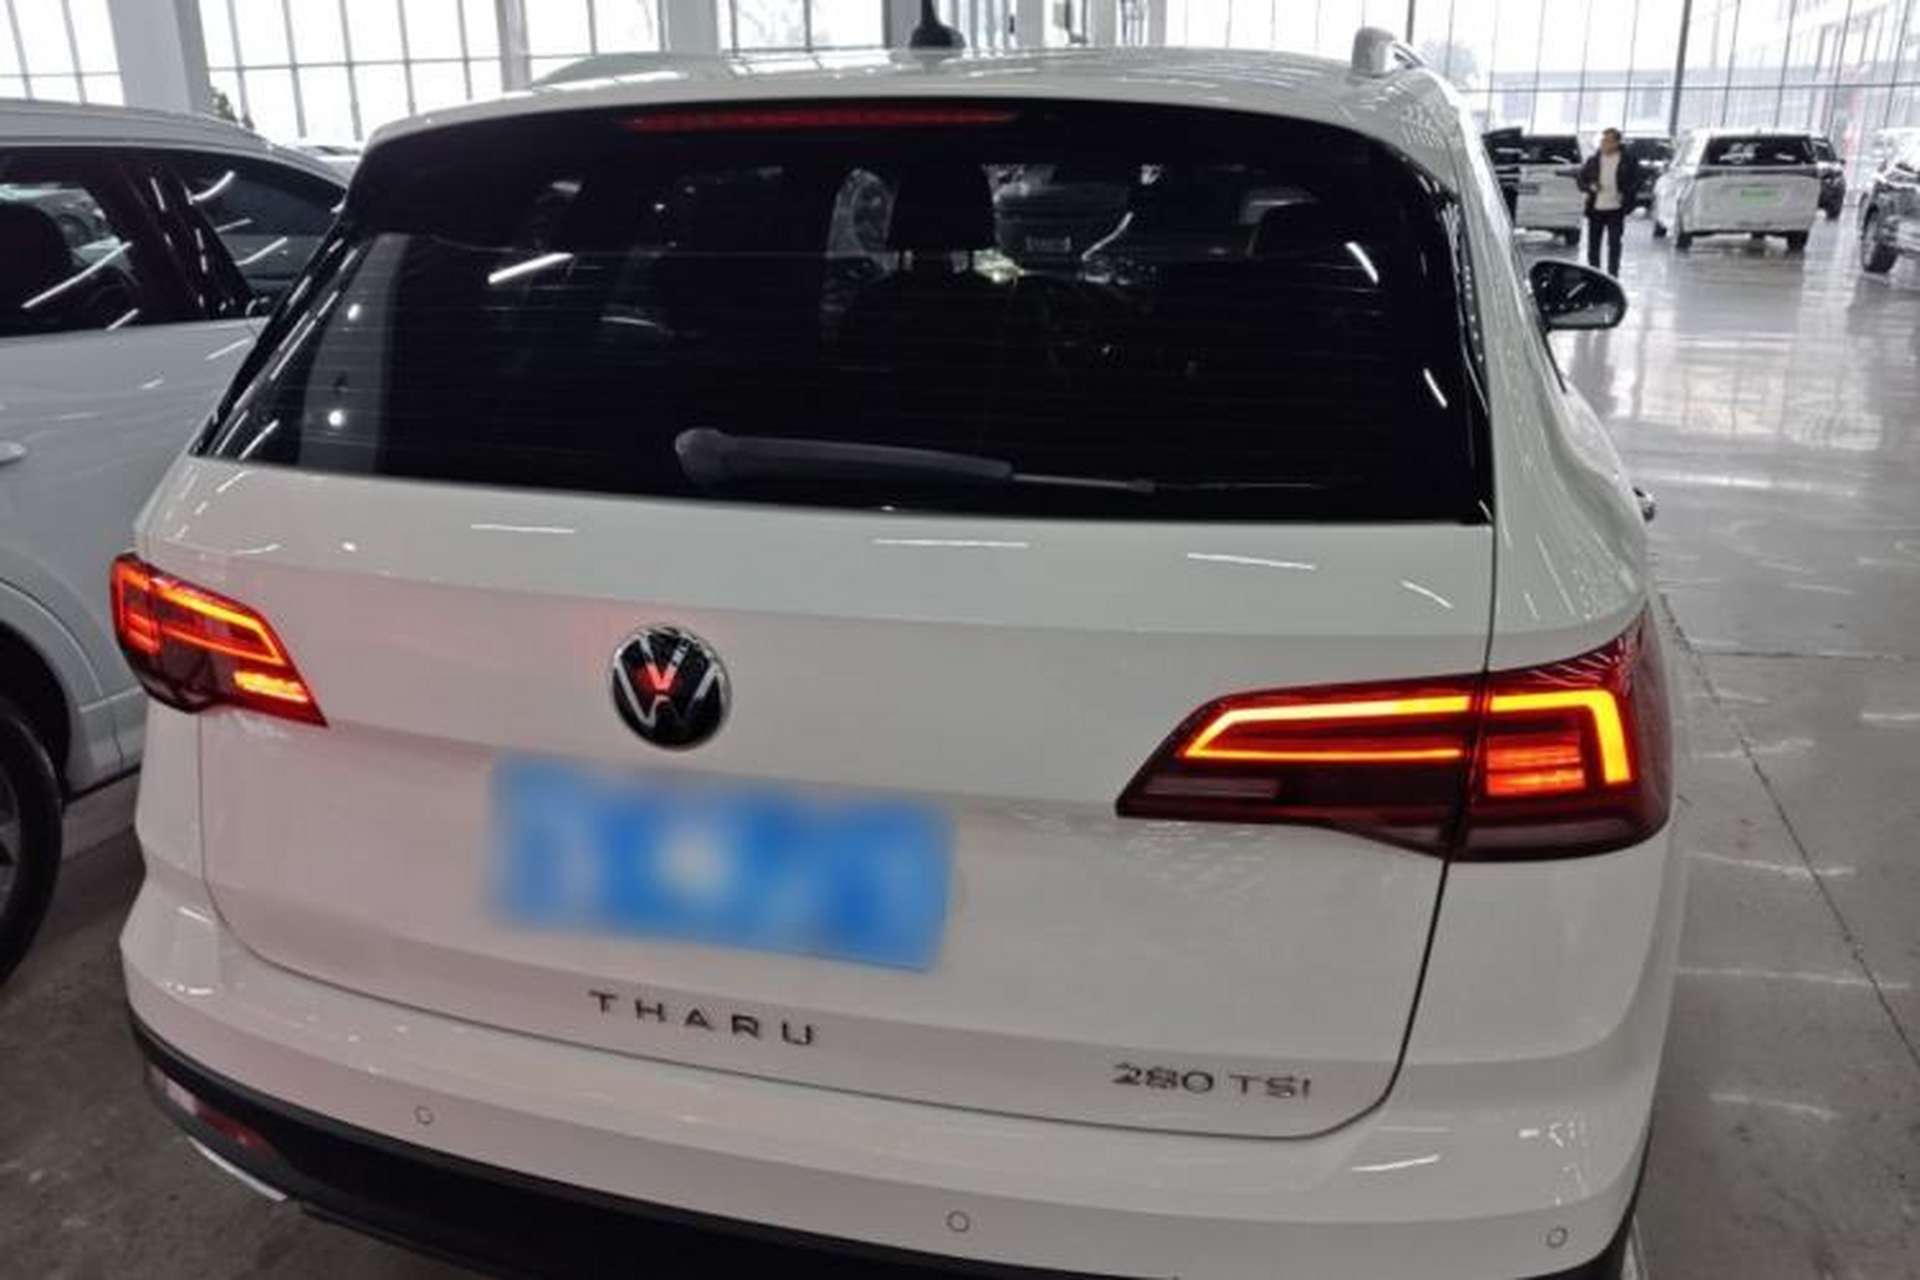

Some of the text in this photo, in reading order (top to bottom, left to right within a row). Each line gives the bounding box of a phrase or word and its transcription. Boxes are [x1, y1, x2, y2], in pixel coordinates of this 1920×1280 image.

[588, 990, 815, 1046] THARU
[1112, 1062, 1311, 1099] 280 TSI
